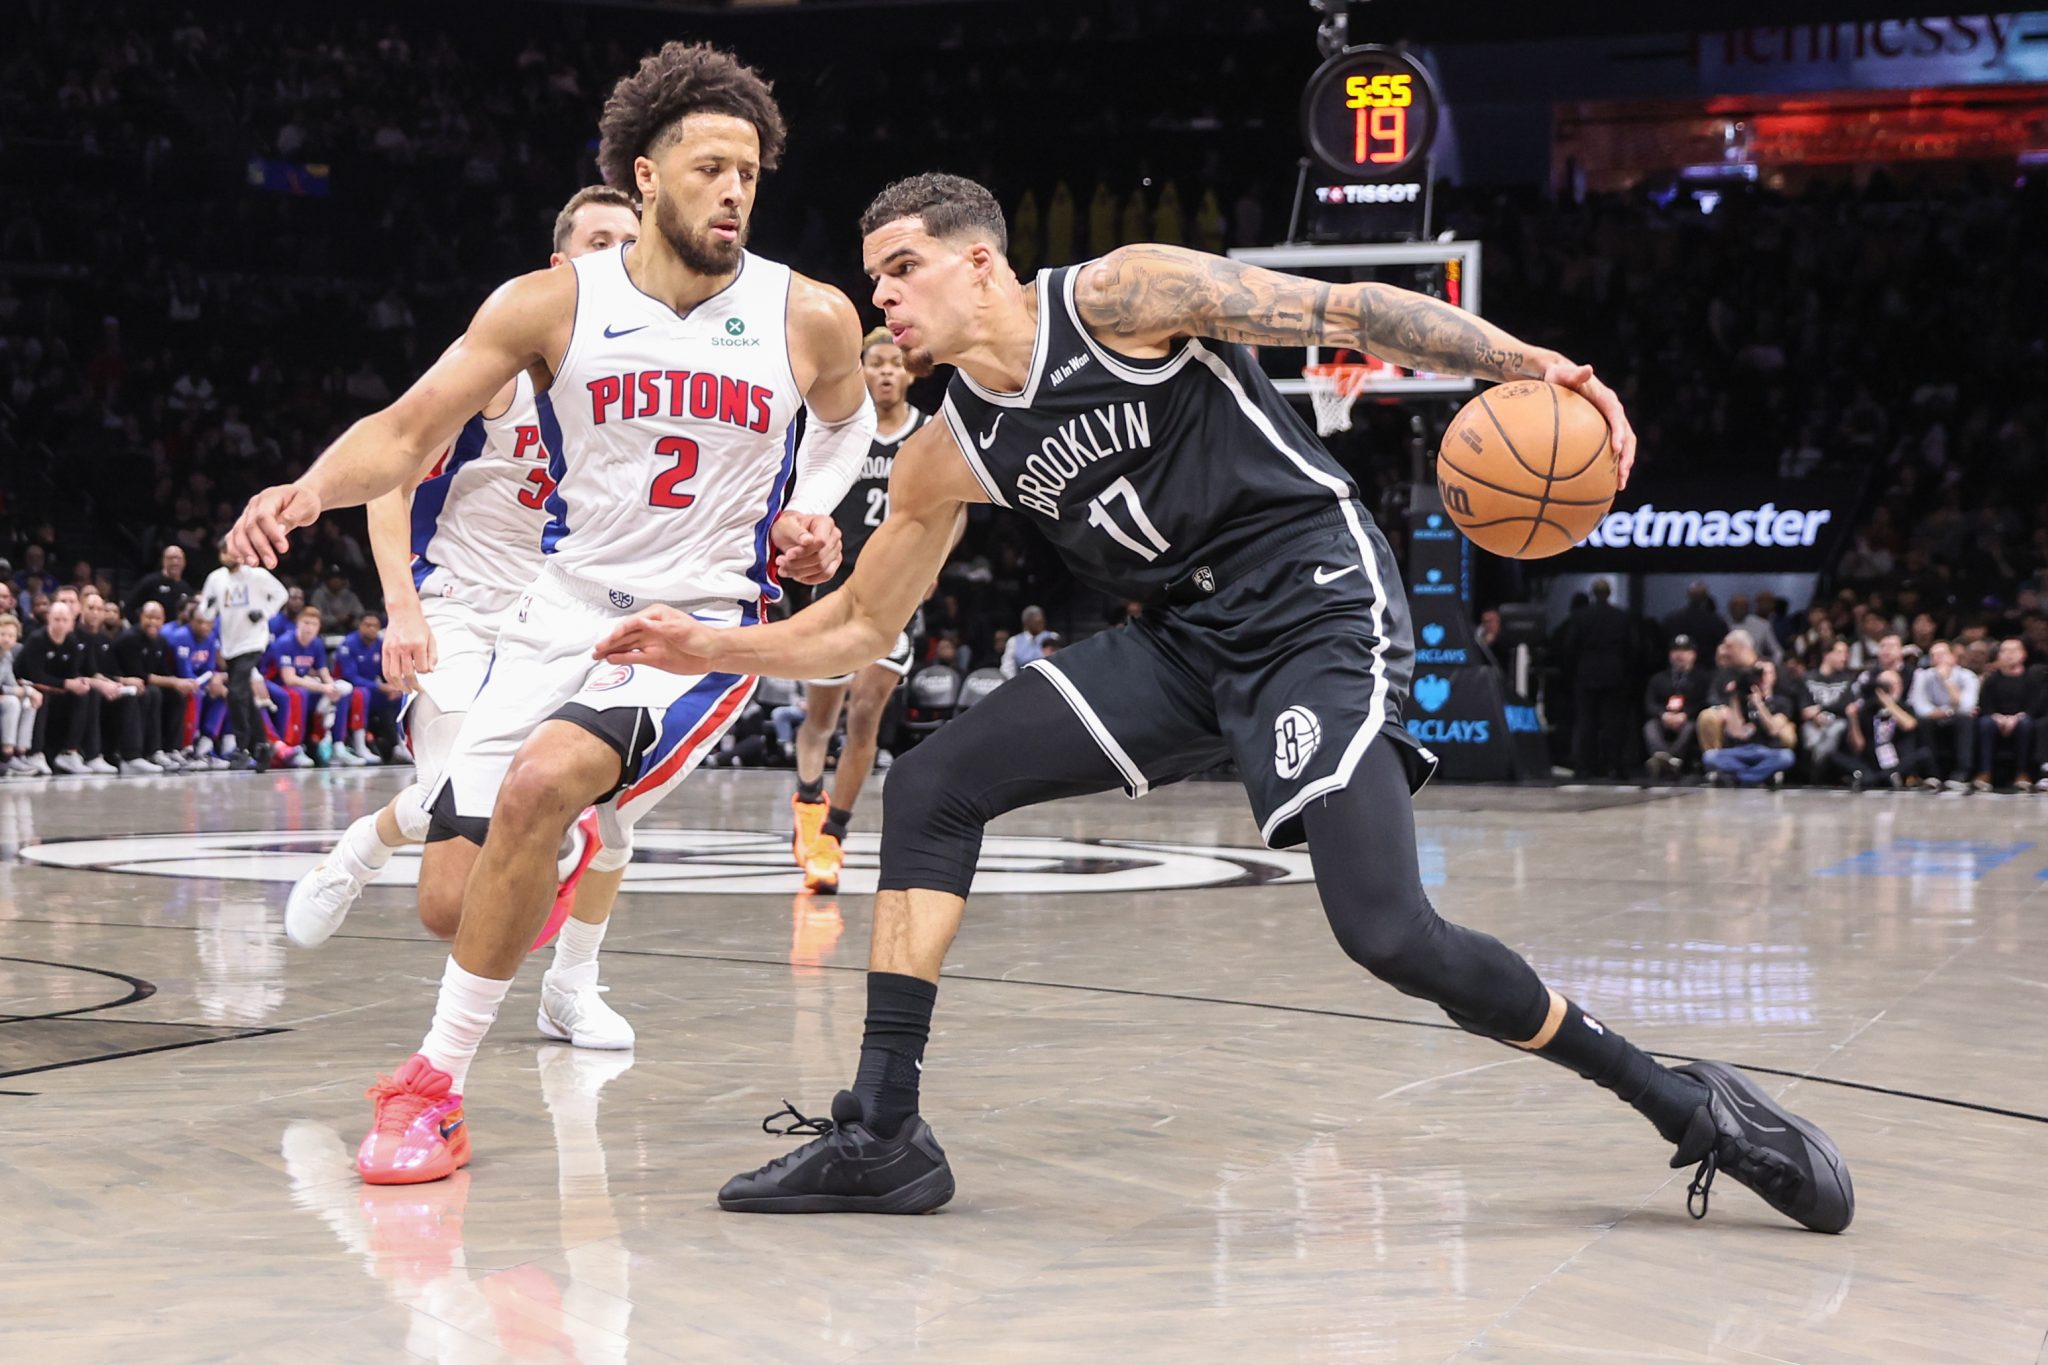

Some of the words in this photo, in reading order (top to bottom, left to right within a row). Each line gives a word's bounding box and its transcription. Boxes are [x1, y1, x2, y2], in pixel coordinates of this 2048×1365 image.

[1345, 75, 1412, 108] 5:55
[1355, 106, 1406, 164] 19
[1343, 183, 1421, 203] TISSOT
[711, 337, 760, 347] StockX
[586, 370, 774, 434] PISTONS
[1050, 368, 1065, 387] All
[1060, 365, 1073, 378] In
[649, 436, 699, 509] 2
[1016, 401, 1151, 520] BROOKLYN
[1088, 475, 1172, 562] 17
